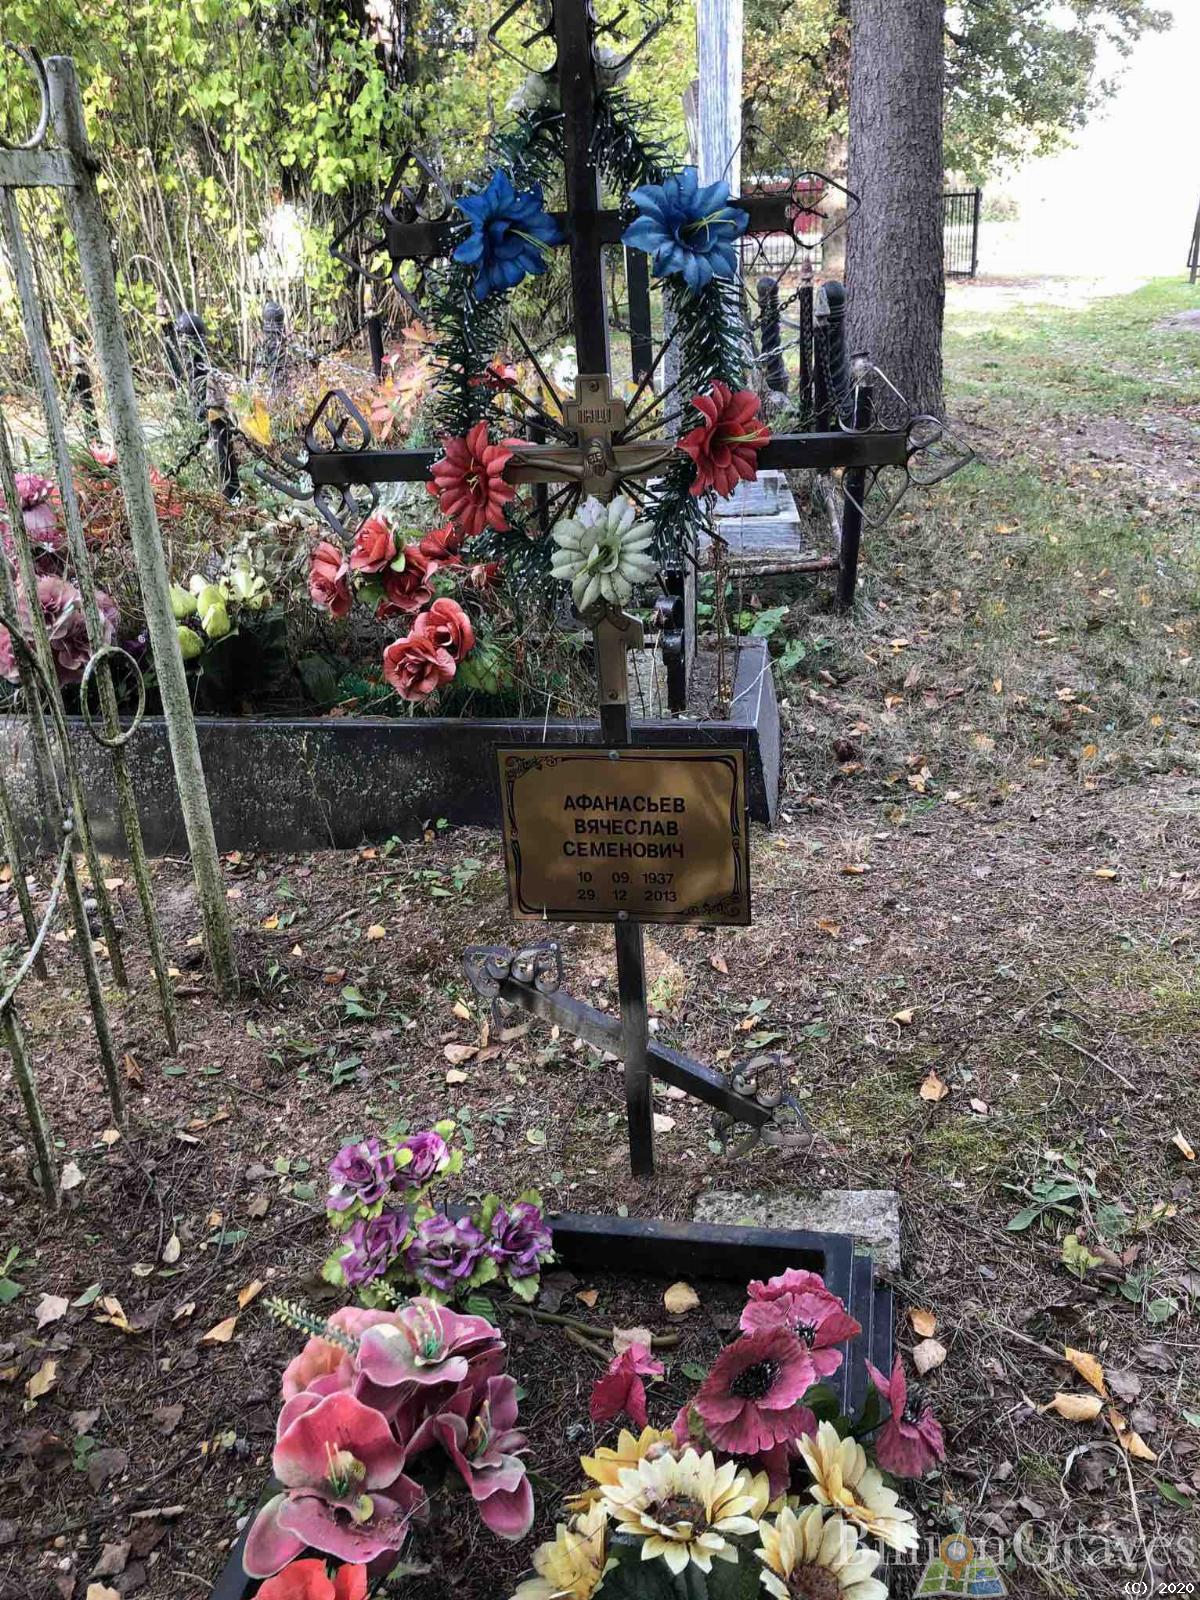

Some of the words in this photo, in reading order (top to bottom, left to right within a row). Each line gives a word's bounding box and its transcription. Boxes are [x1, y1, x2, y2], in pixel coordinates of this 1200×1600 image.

[563, 793, 686, 813] АФАНАСЬЕВ
[574, 818, 679, 836] ВЯЧЕСЛАВ
[562, 840, 685, 859] СЕМЕНОВИЧ
[577, 871, 593, 883] 10
[641, 872, 675, 885] 1937
[612, 889, 628, 901] 12
[644, 890, 678, 902] 2013
